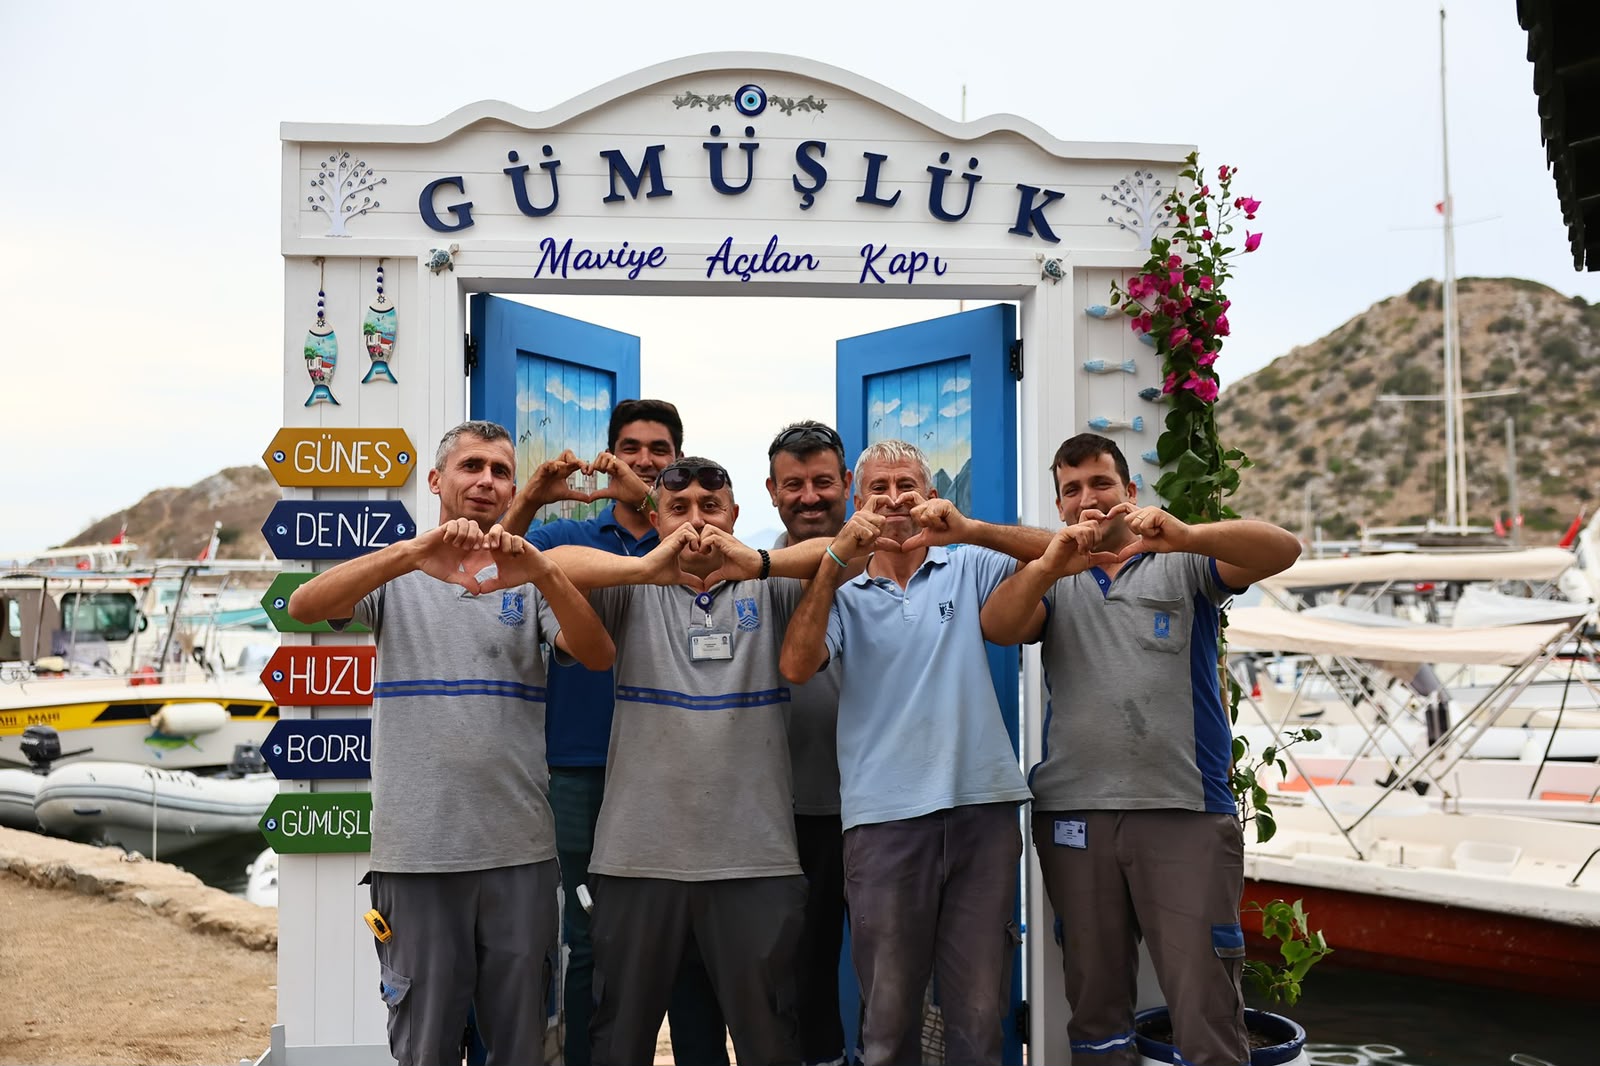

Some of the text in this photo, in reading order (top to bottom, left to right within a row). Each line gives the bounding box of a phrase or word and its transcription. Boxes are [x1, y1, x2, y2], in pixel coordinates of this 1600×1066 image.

[418, 125, 1066, 244] GÜMÜŞLÜK
[535, 235, 947, 285] Maviye Açılan Kapı
[294, 433, 392, 479] GÜNEŞ
[295, 505, 391, 548] DENİZ
[288, 655, 375, 696] HUZU
[281, 805, 373, 839] GÜMÜŞL
